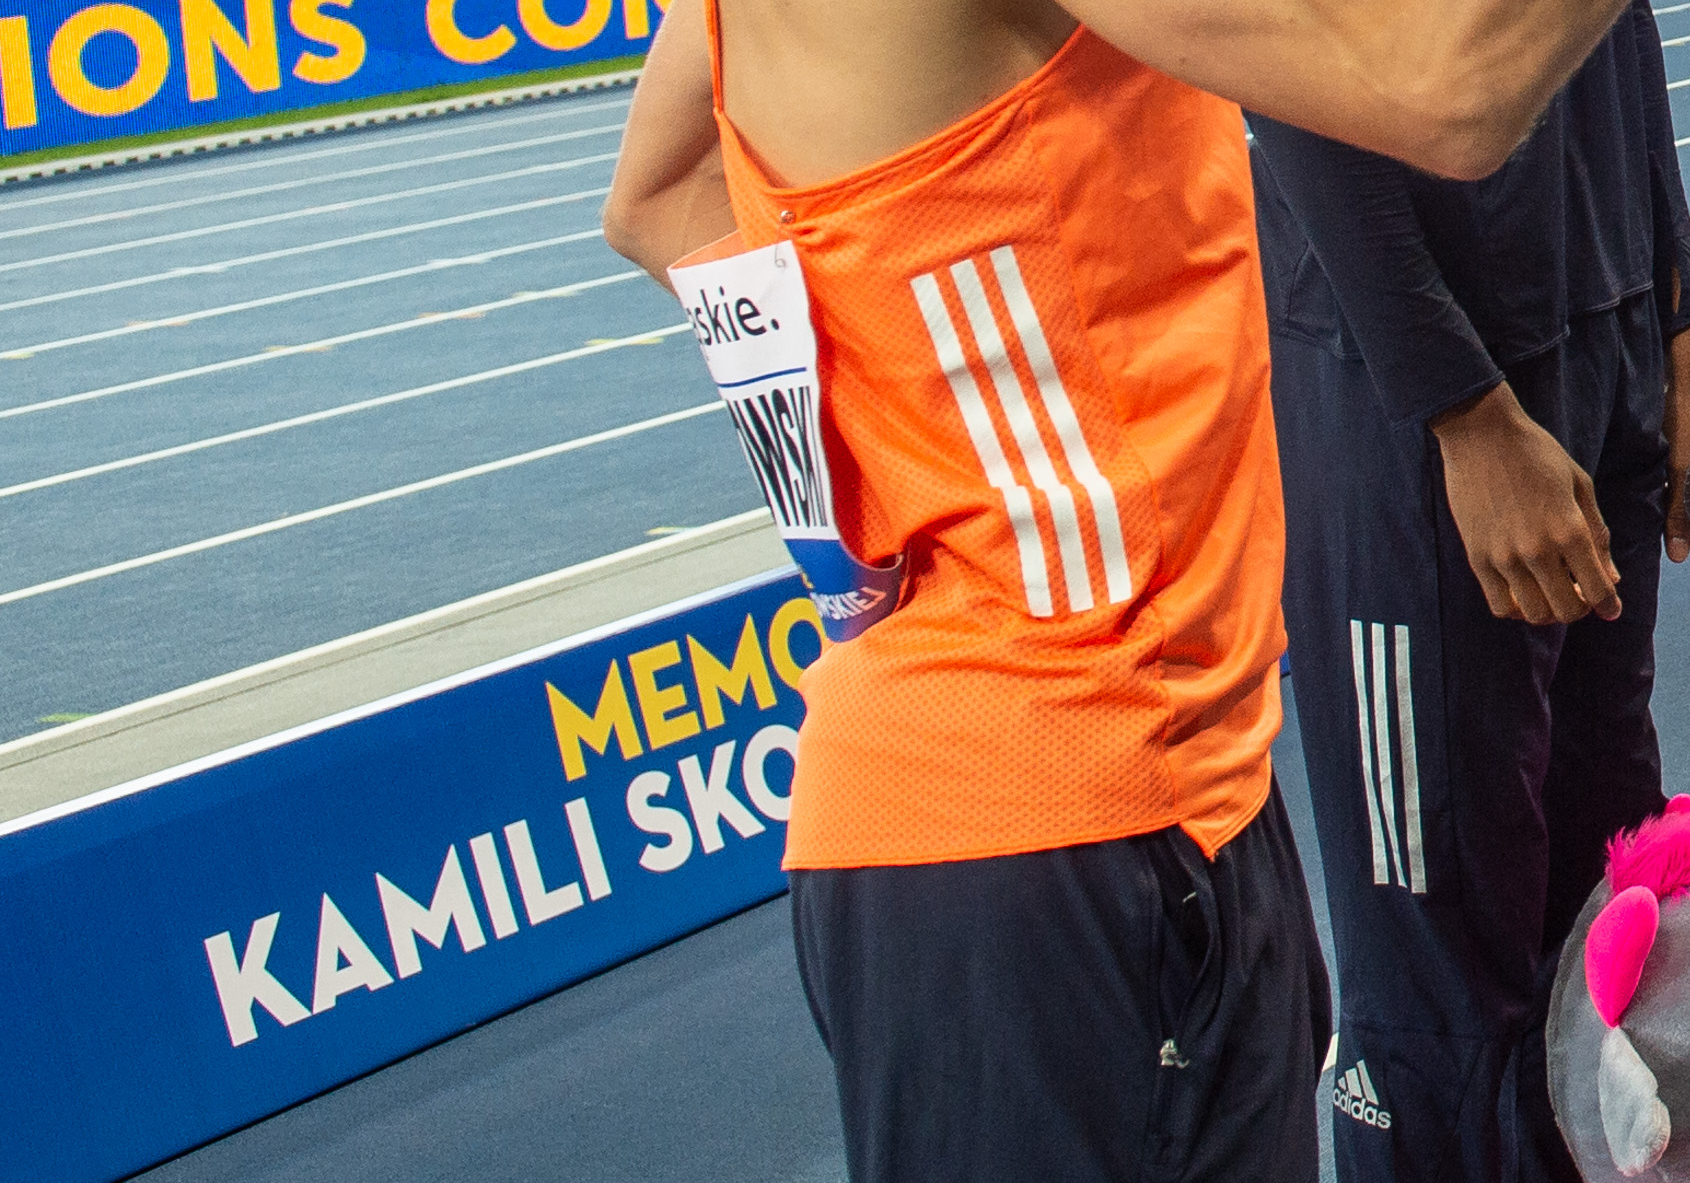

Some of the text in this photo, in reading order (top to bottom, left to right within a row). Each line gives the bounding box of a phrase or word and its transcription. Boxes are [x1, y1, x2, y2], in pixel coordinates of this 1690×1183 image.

[686, 285, 780, 347] skie.
[204, 798, 612, 1047] KAMILI
[1333, 1087, 1392, 1130] adidas
